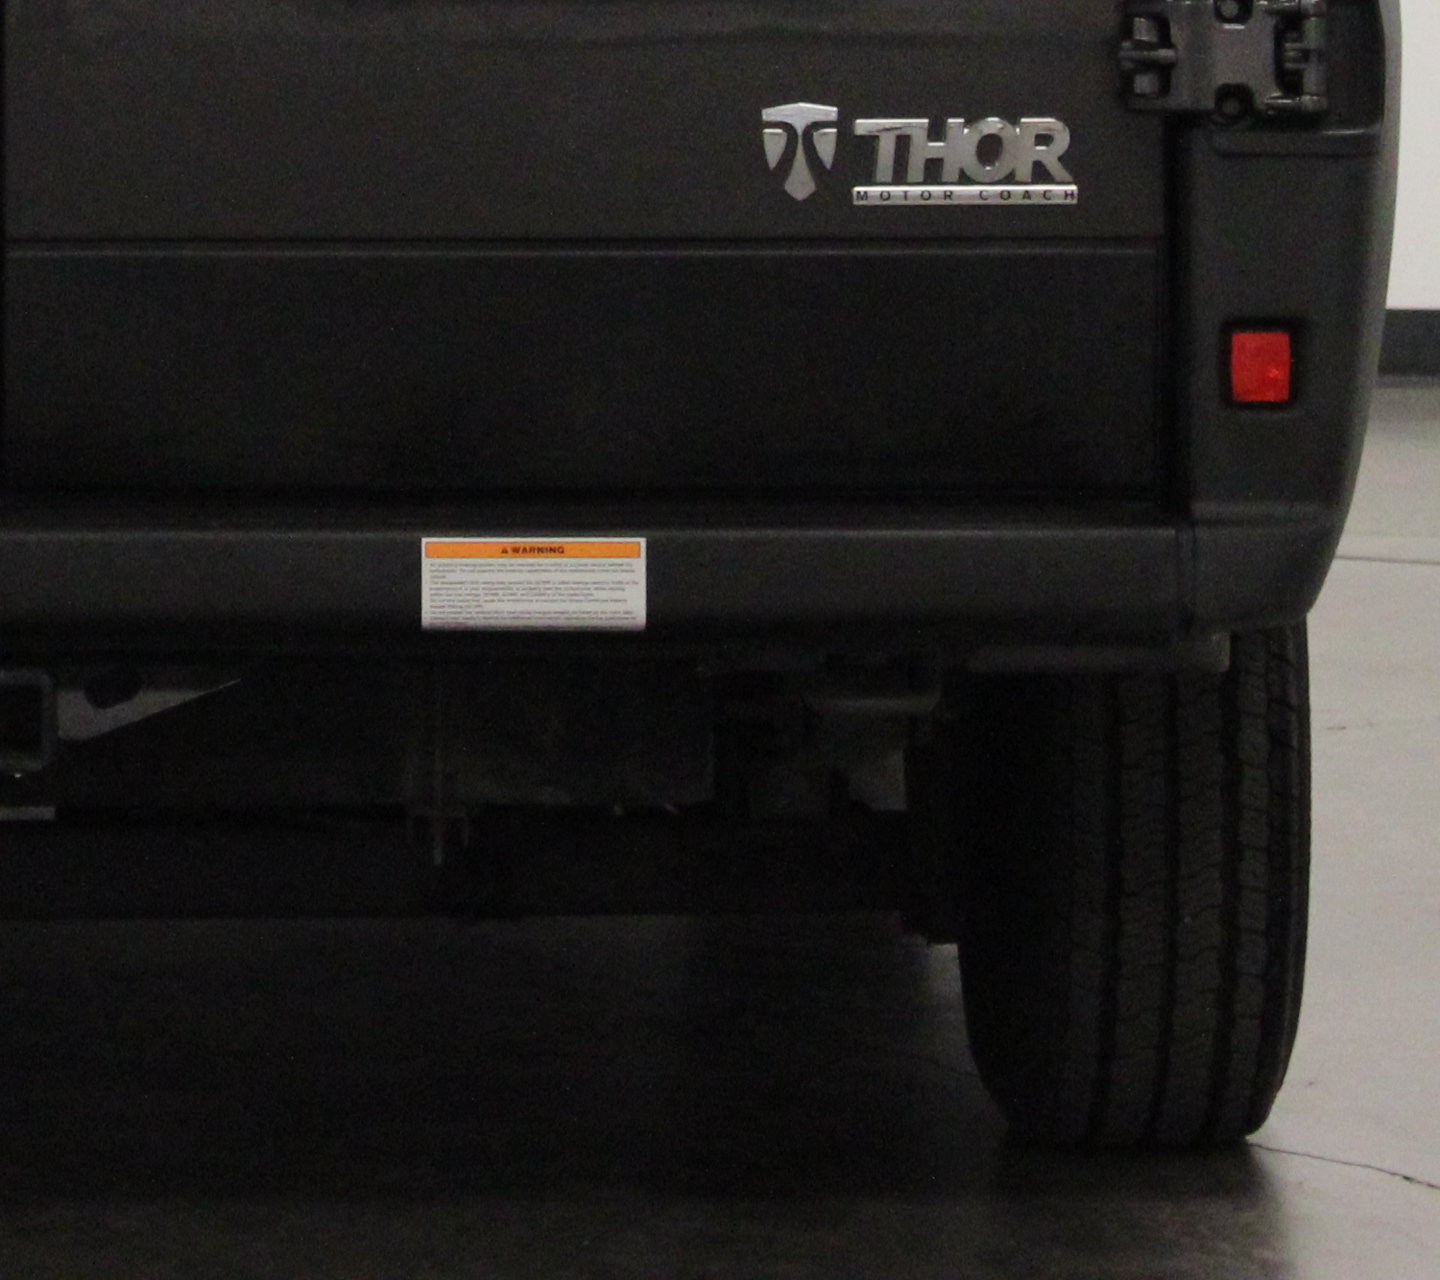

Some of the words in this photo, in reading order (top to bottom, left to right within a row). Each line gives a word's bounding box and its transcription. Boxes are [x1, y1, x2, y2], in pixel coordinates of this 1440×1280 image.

[853, 116, 1074, 183] THOR
[855, 189, 954, 202] MOTOR
[979, 189, 1077, 202] COACH
[510, 545, 566, 555] WARNING
